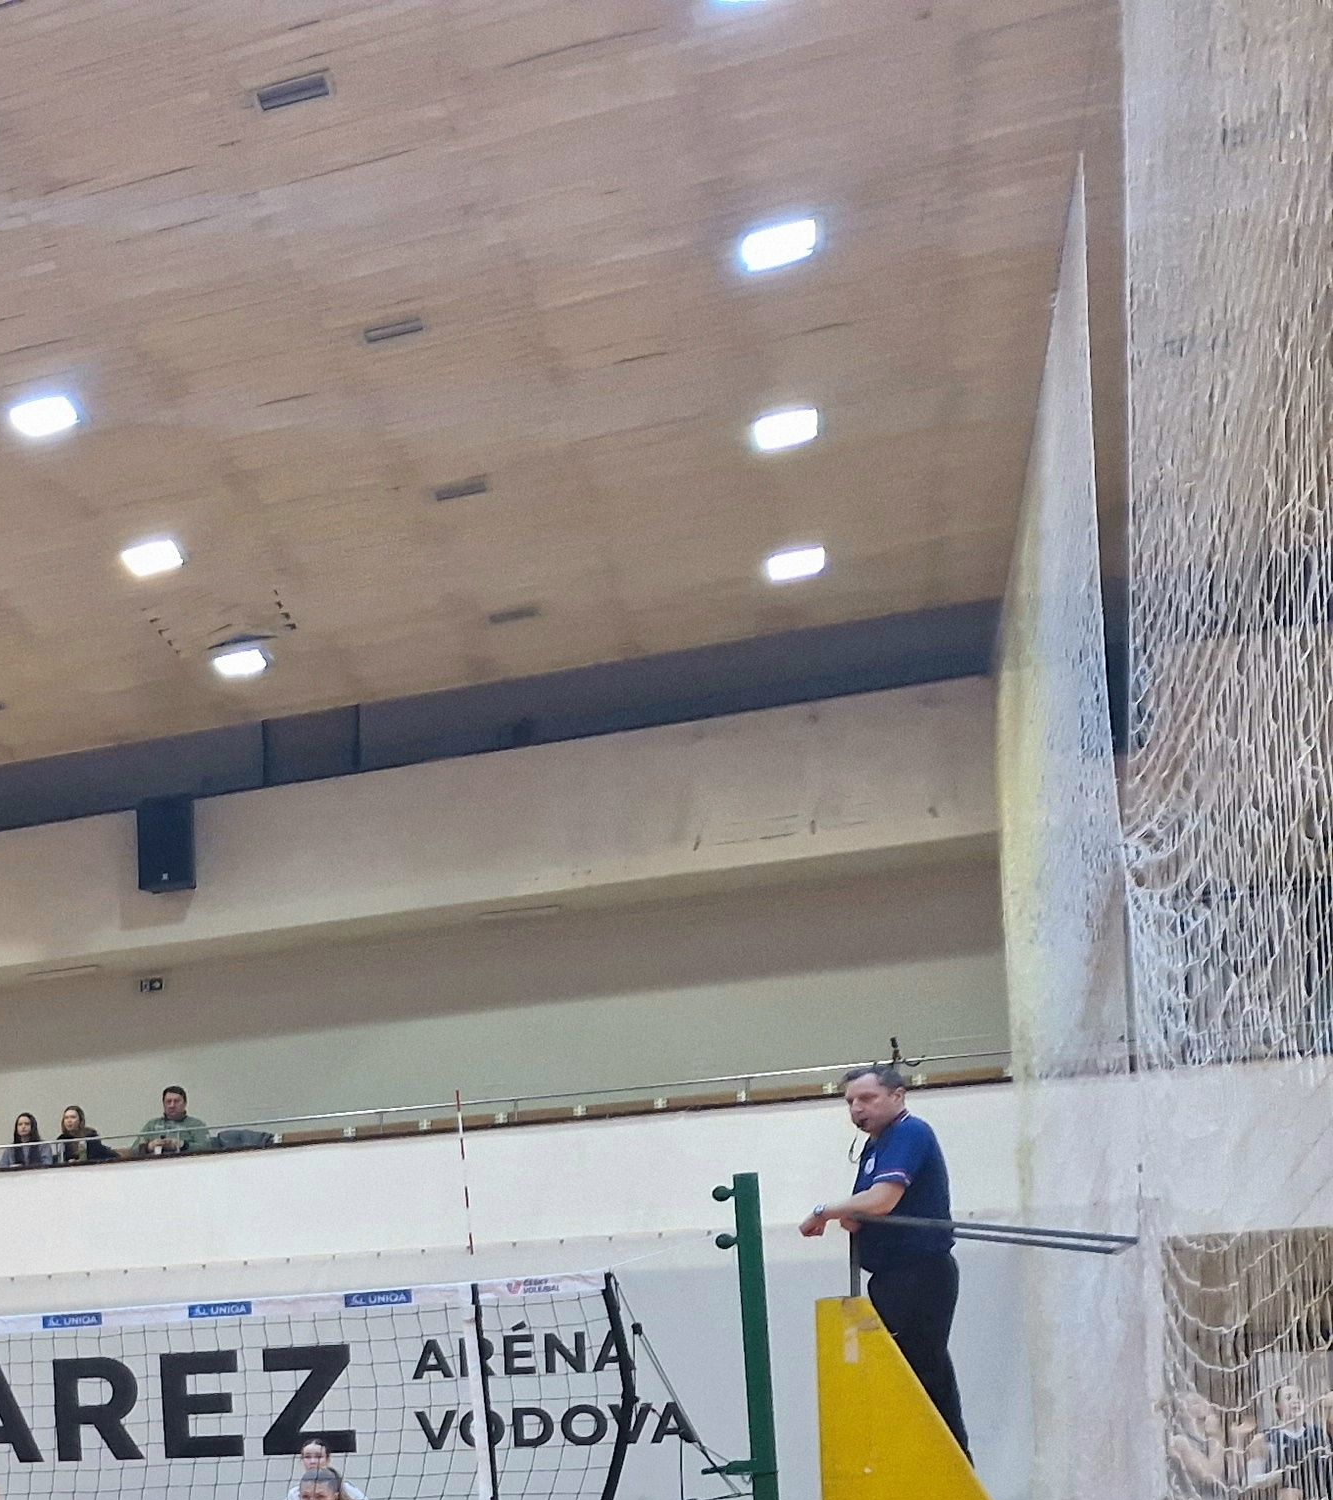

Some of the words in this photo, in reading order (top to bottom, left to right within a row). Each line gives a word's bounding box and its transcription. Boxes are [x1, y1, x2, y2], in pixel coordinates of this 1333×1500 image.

[369, 1292, 407, 1303] UNIQA
[210, 1305, 247, 1315] UNIQA
[64, 1316, 98, 1325] UNIQA
[412, 1320, 636, 1380] ARÉNA
[414, 1401, 697, 1451] VODOVA
